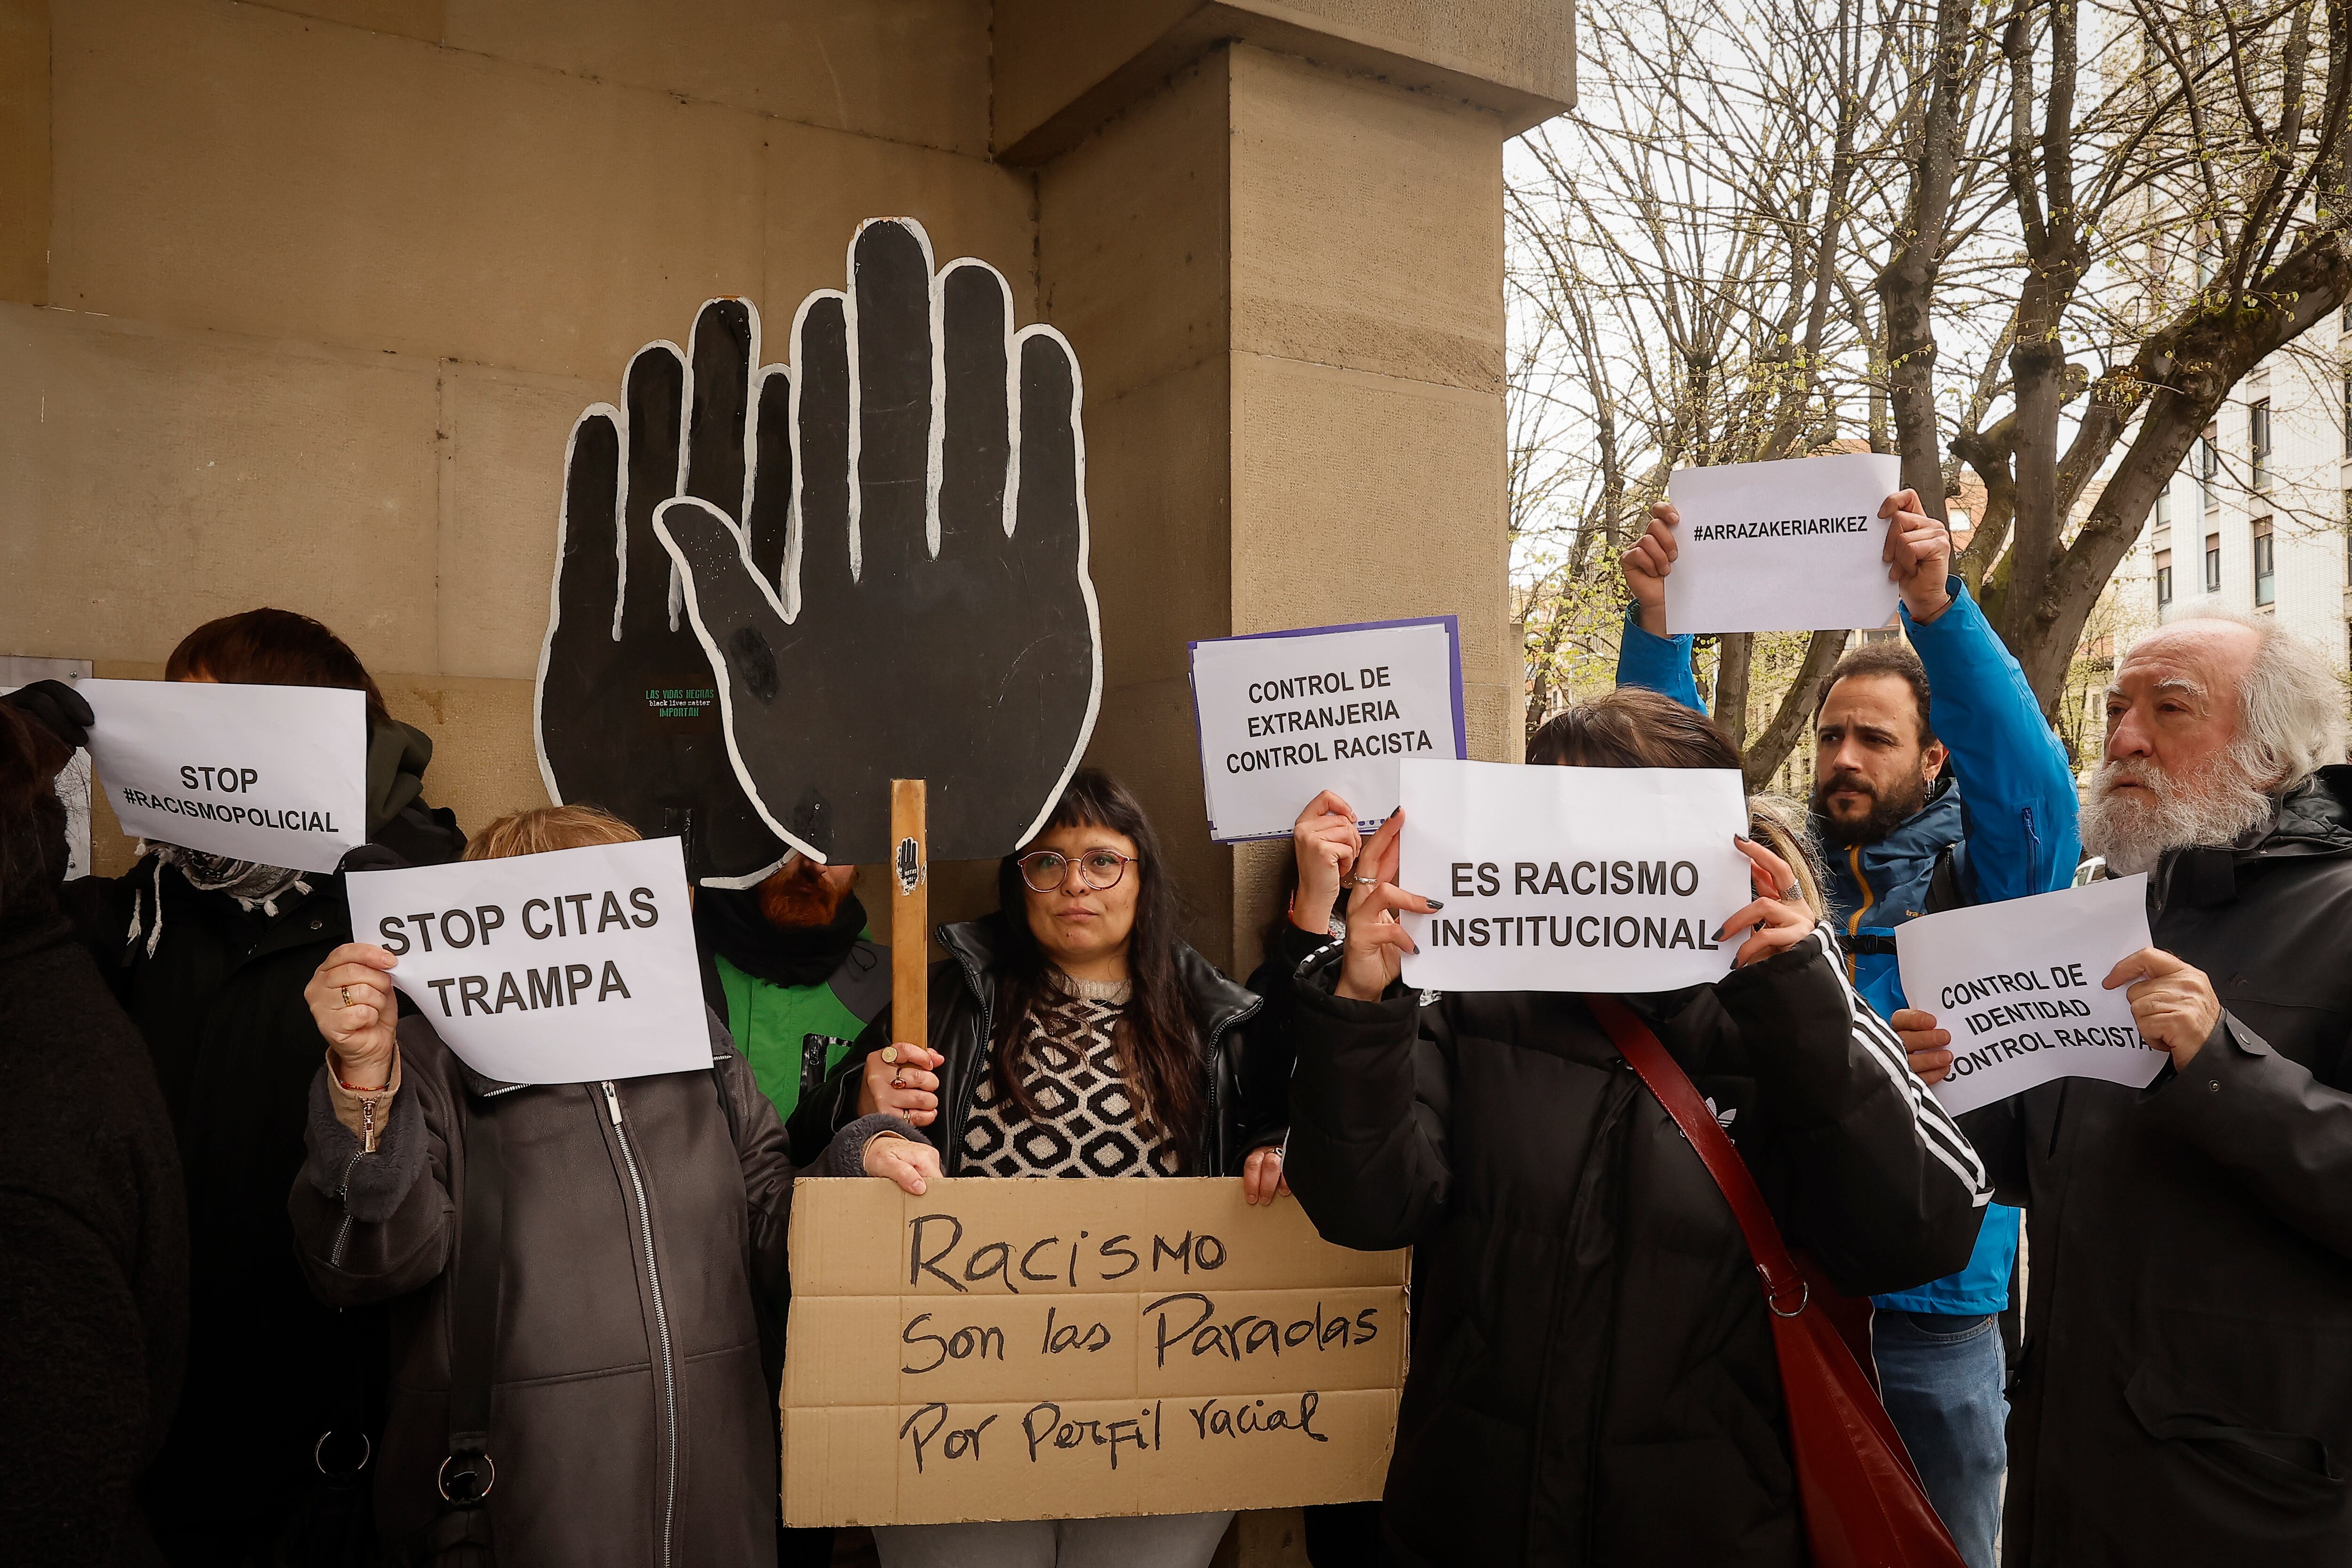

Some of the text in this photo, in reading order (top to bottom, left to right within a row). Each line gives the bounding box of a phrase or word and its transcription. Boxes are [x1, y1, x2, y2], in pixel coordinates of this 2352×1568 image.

[1694, 516, 1867, 541] #ARRAZAKERIARIKEZ
[645, 689, 715, 700] LAS VIDAS NEGRAS
[1249, 666, 1391, 704] CONTROL DE
[659, 707, 699, 717] IMPORTAN
[1248, 699, 1400, 738] EXTRANJERIA
[1226, 730, 1433, 774] CONTROL RACISTA
[180, 765, 258, 793] STOP
[123, 788, 339, 833] #RACISMOPOLICIAL
[1452, 860, 1699, 897] ES RACISMO
[379, 887, 659, 956] STOP CITAS
[1432, 915, 1719, 951] INSTITUCIONAL
[427, 960, 631, 1017] TRAMPA
[1941, 963, 2088, 1010] CONTROL DE
[1964, 999, 2091, 1036] IDENTIDAD
[1041, 1306, 1111, 1354] las
[1142, 1293, 1378, 1370] Paradas
[899, 1402, 998, 1474] Por
[1189, 1392, 1329, 1442] racial
